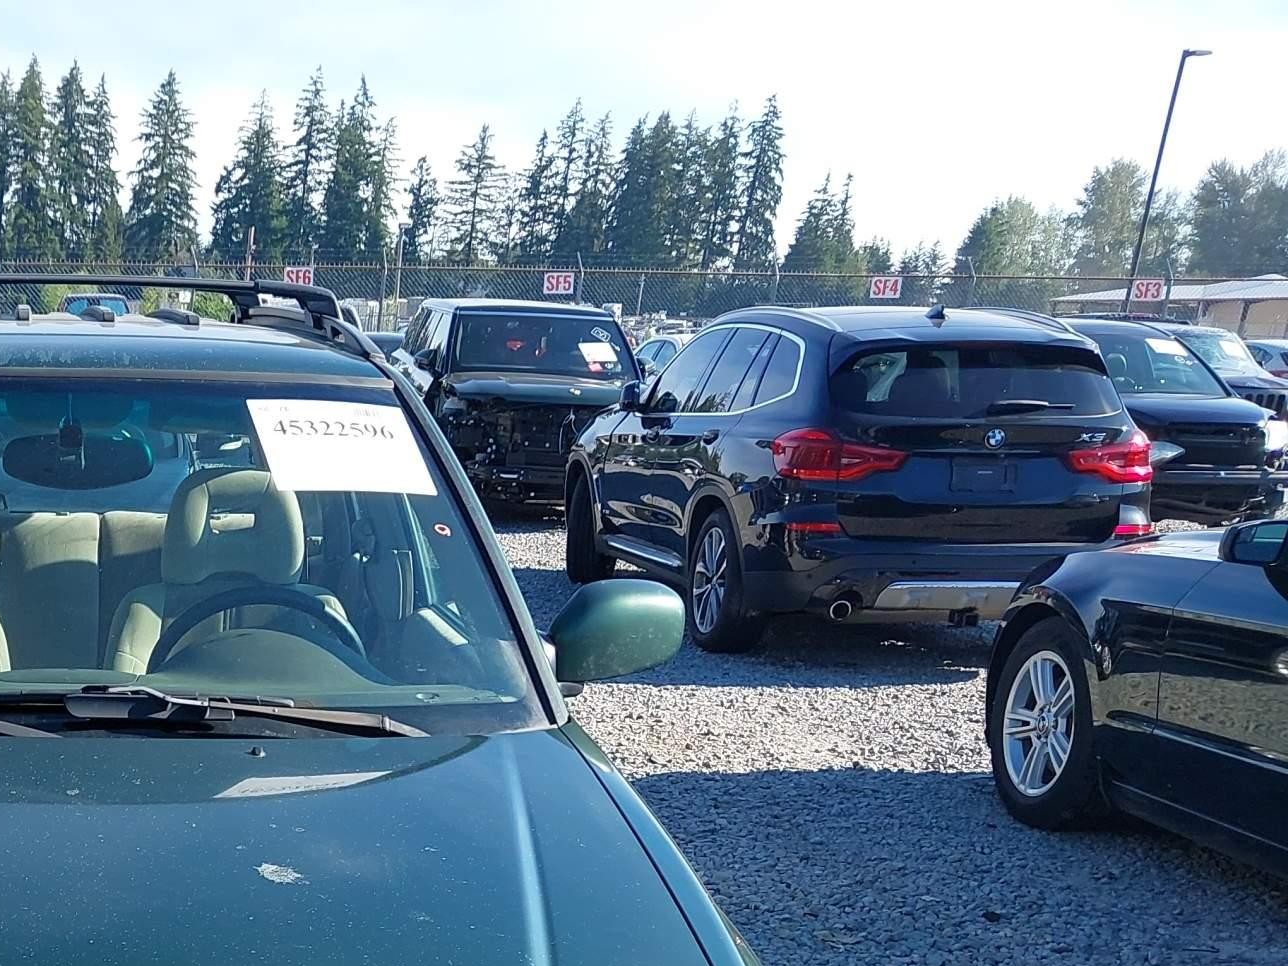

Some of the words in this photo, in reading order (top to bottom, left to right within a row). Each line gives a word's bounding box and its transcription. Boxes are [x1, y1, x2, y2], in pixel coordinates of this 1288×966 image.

[286, 269, 312, 285] SF6
[546, 274, 572, 291] SF5
[872, 279, 899, 296] SF4
[1134, 281, 1162, 299] SF3
[273, 419, 395, 440] 45322596
[1074, 432, 1108, 442] X3
